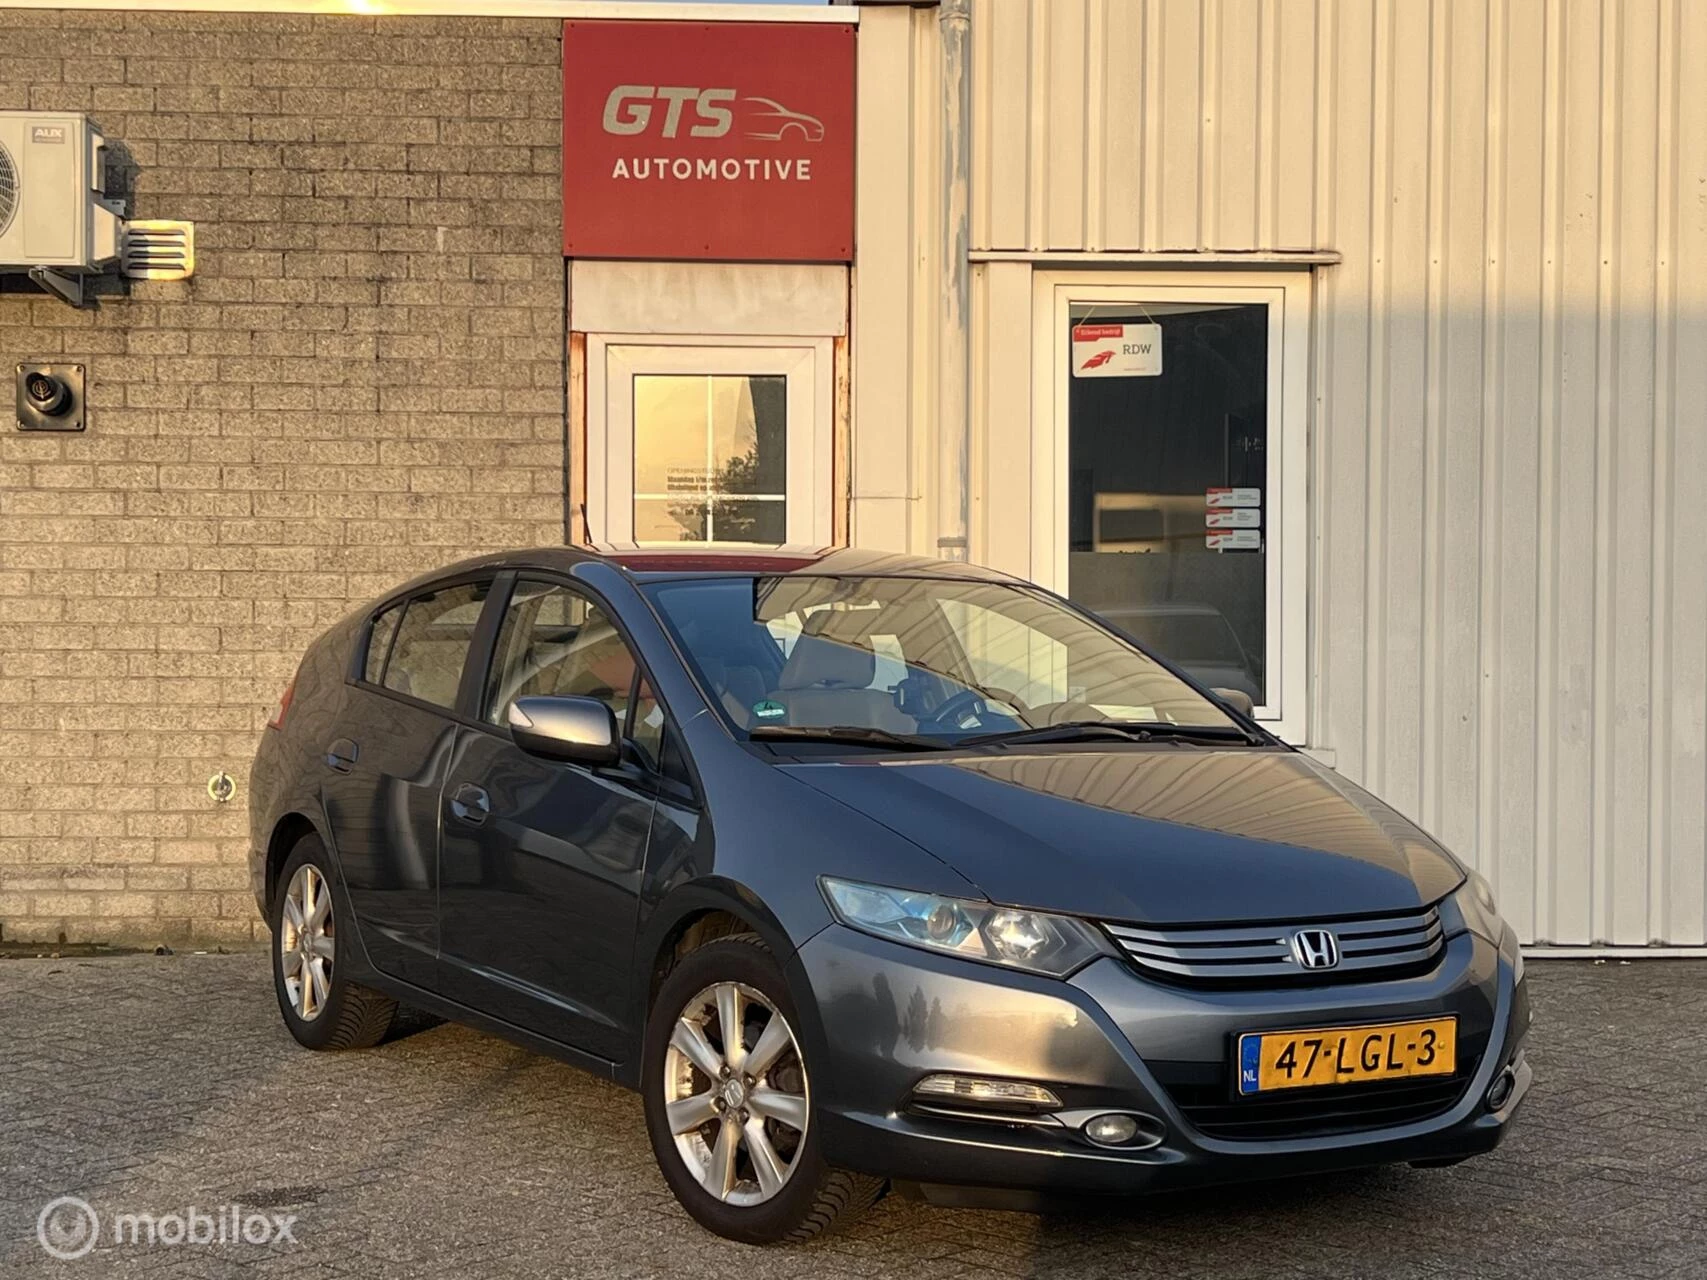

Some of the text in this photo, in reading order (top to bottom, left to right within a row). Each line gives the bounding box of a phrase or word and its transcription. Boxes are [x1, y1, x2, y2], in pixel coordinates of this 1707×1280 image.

[603, 85, 737, 139] GTS
[612, 158, 811, 181] AUTOMOTIVE
[1122, 344, 1152, 355] RDW
[1275, 1029, 1437, 1079] 47-LGL-3
[1243, 1069, 1257, 1082] NL
